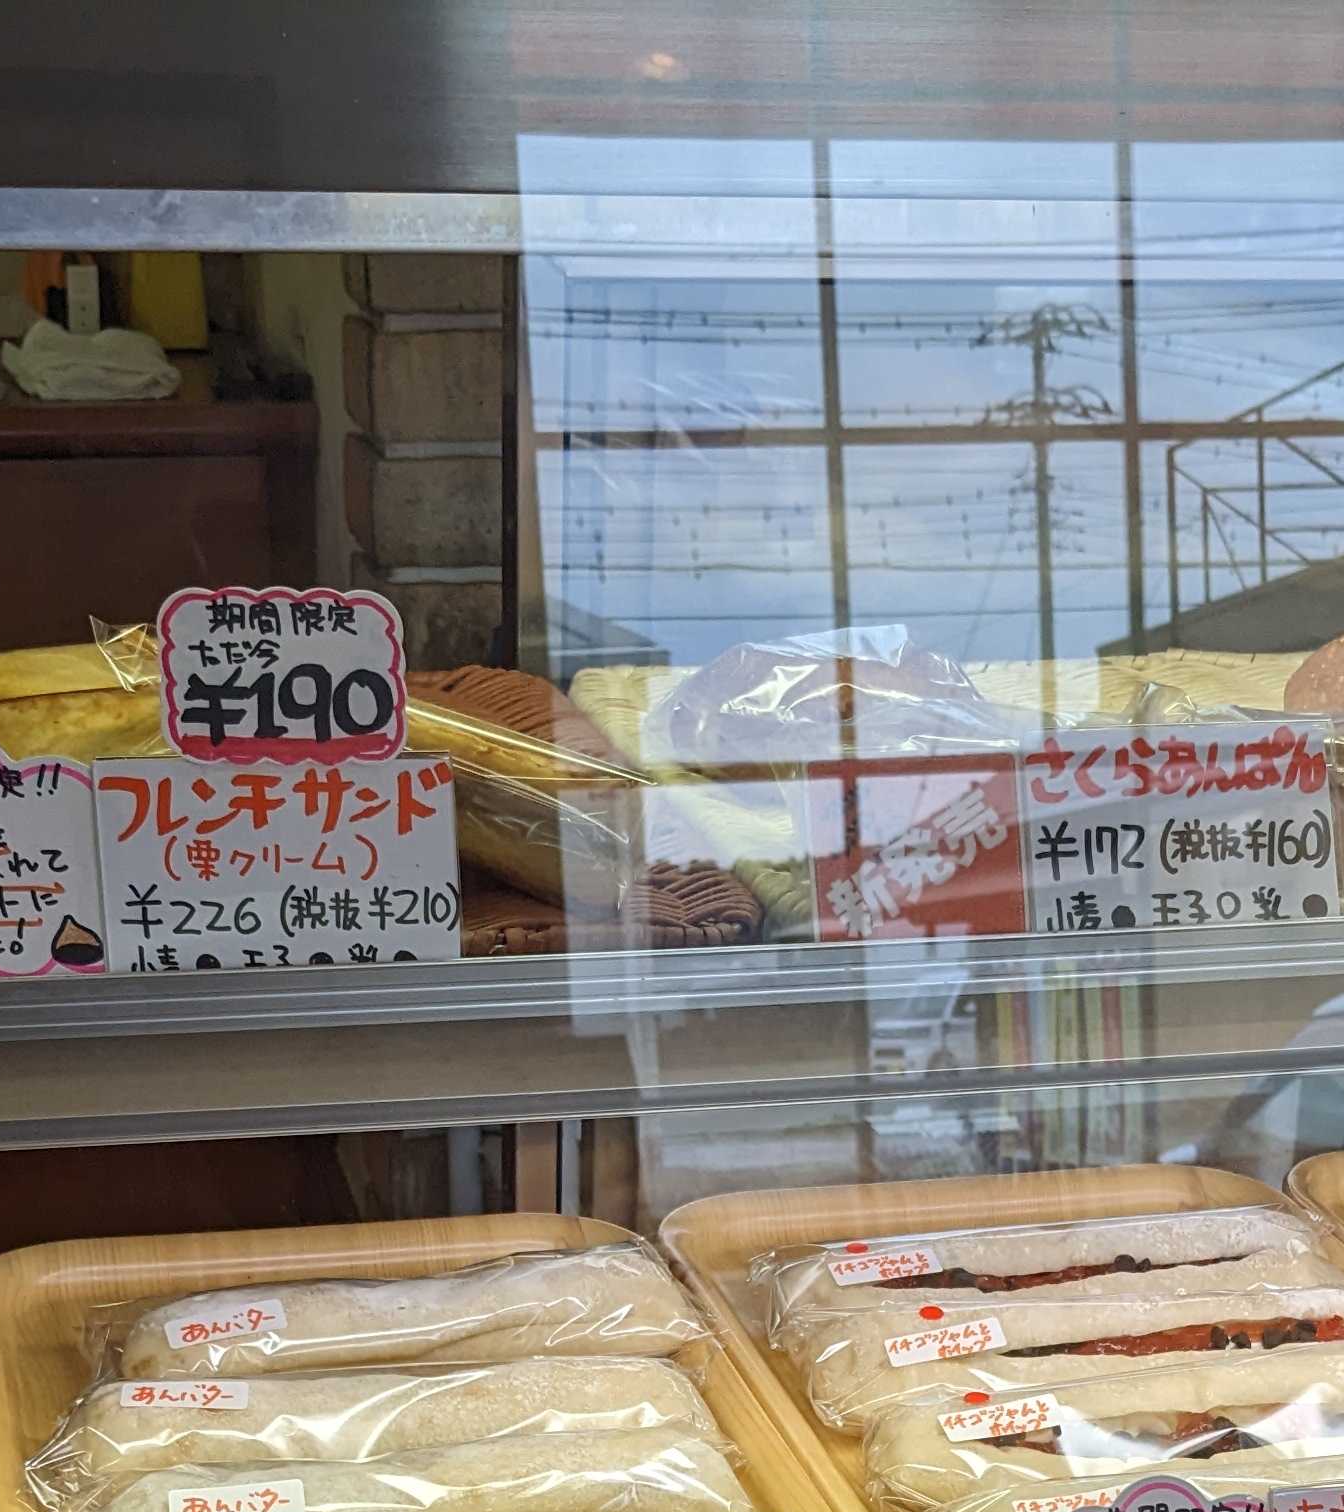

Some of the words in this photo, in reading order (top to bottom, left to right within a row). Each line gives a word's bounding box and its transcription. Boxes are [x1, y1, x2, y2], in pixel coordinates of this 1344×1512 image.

[207, 601, 357, 637] 期間限定
[190, 640, 280, 670] ただ今
[182, 664, 393, 746] ¥190
[1025, 726, 1328, 803] さくらあんぱん
[99, 761, 454, 842] フレンチサンド
[164, 835, 378, 881] (栗クリーム)
[826, 782, 1007, 938] 新発売
[1035, 821, 1145, 881] ¥172
[1161, 810, 1331, 874] (税抜¥160)
[121, 884, 262, 938] ¥226
[181, 1309, 276, 1342] あんバター
[131, 1384, 234, 1406] あんバター
